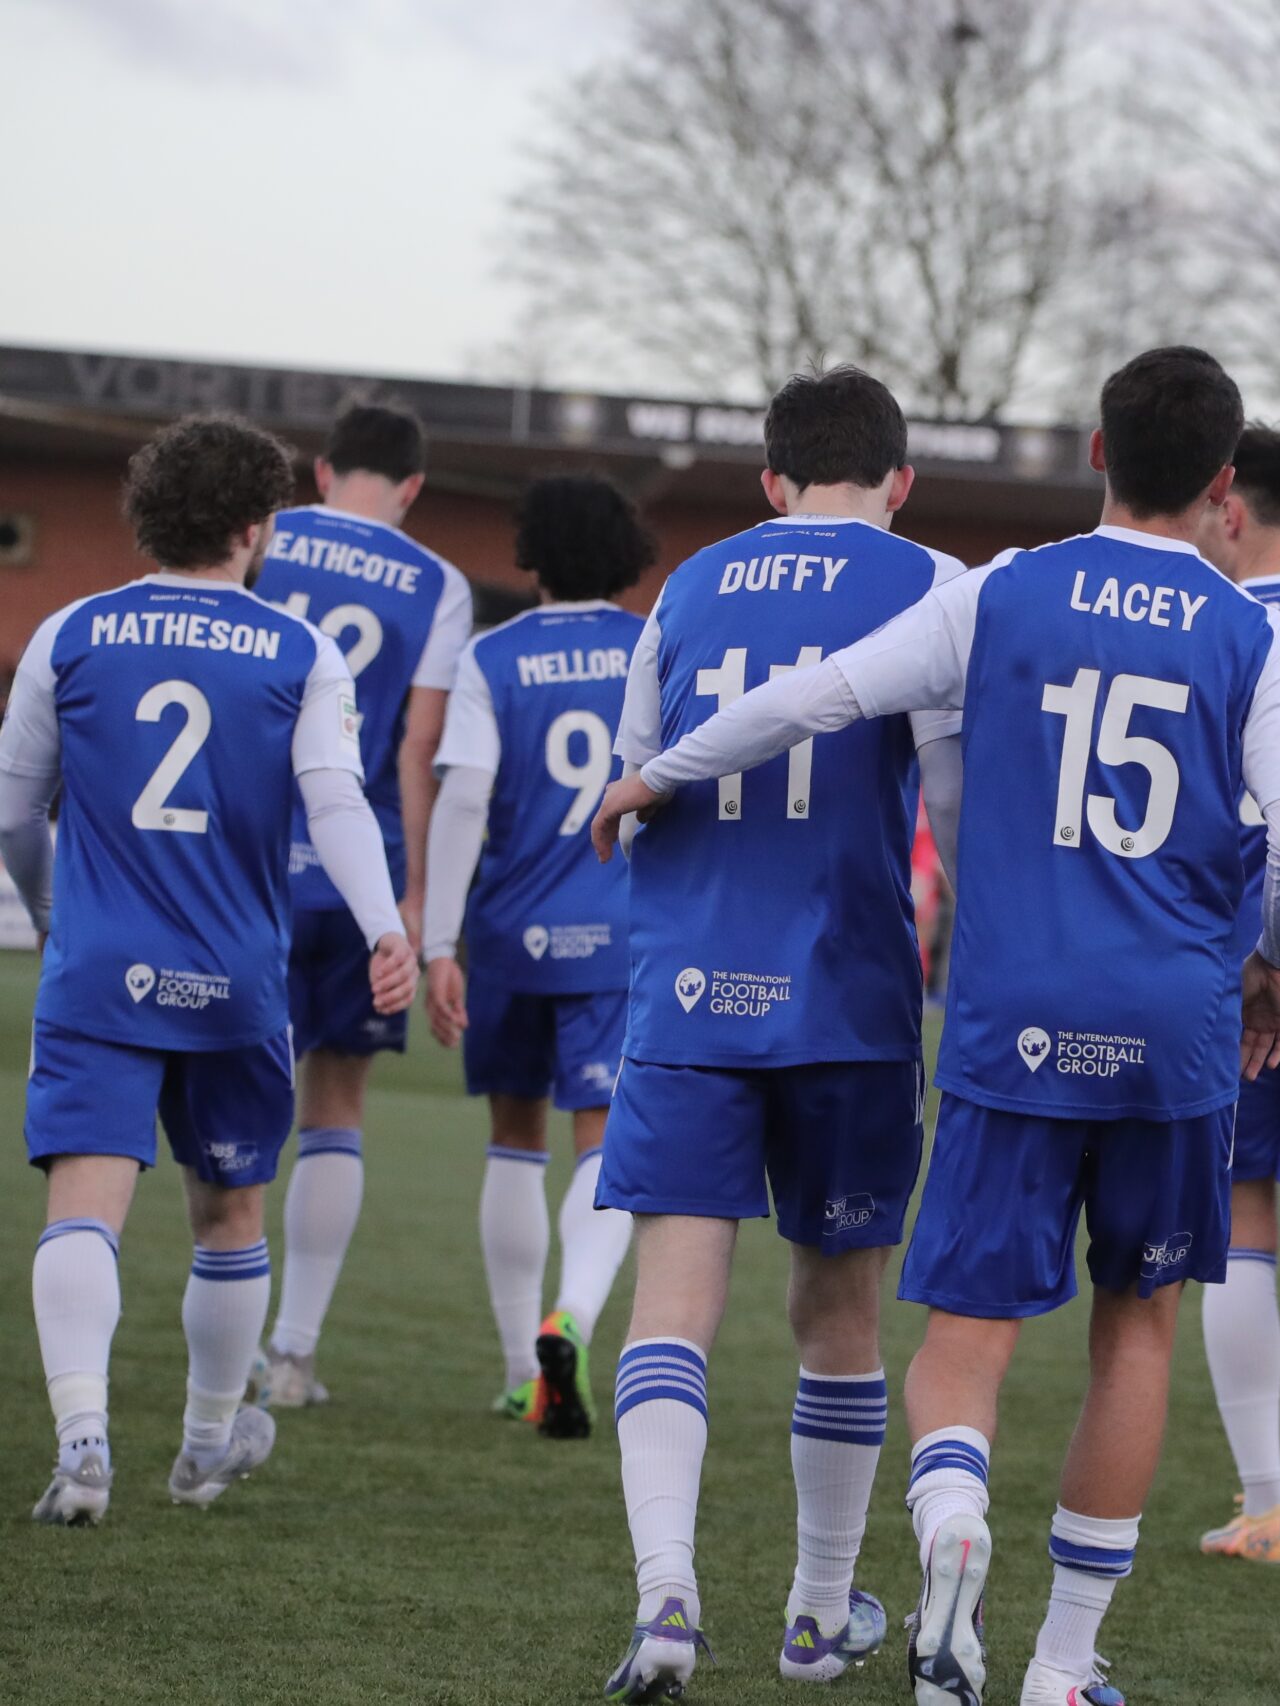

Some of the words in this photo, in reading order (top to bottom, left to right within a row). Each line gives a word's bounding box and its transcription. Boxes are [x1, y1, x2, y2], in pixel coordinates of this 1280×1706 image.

[718, 554, 848, 594] DUFFY
[1070, 570, 1208, 631] LACEY
[91, 611, 280, 660] MATHESON
[517, 648, 628, 687] MELLOR
[132, 679, 212, 833] 2
[1041, 668, 1190, 858] 15
[545, 709, 612, 836] 9
[158, 977, 230, 999] FOOTBALL
[712, 971, 727, 980] THE
[730, 972, 791, 985] INTERNATIONAL
[156, 991, 210, 1010] GROUP
[711, 982, 790, 1001] FOOTBALL
[710, 998, 771, 1016] GROUP
[1058, 1031, 1074, 1040] THE
[1076, 1033, 1146, 1046] INTERNATIONAL
[1057, 1042, 1144, 1063] FOOTBALL
[1057, 1058, 1120, 1077] GROUP
